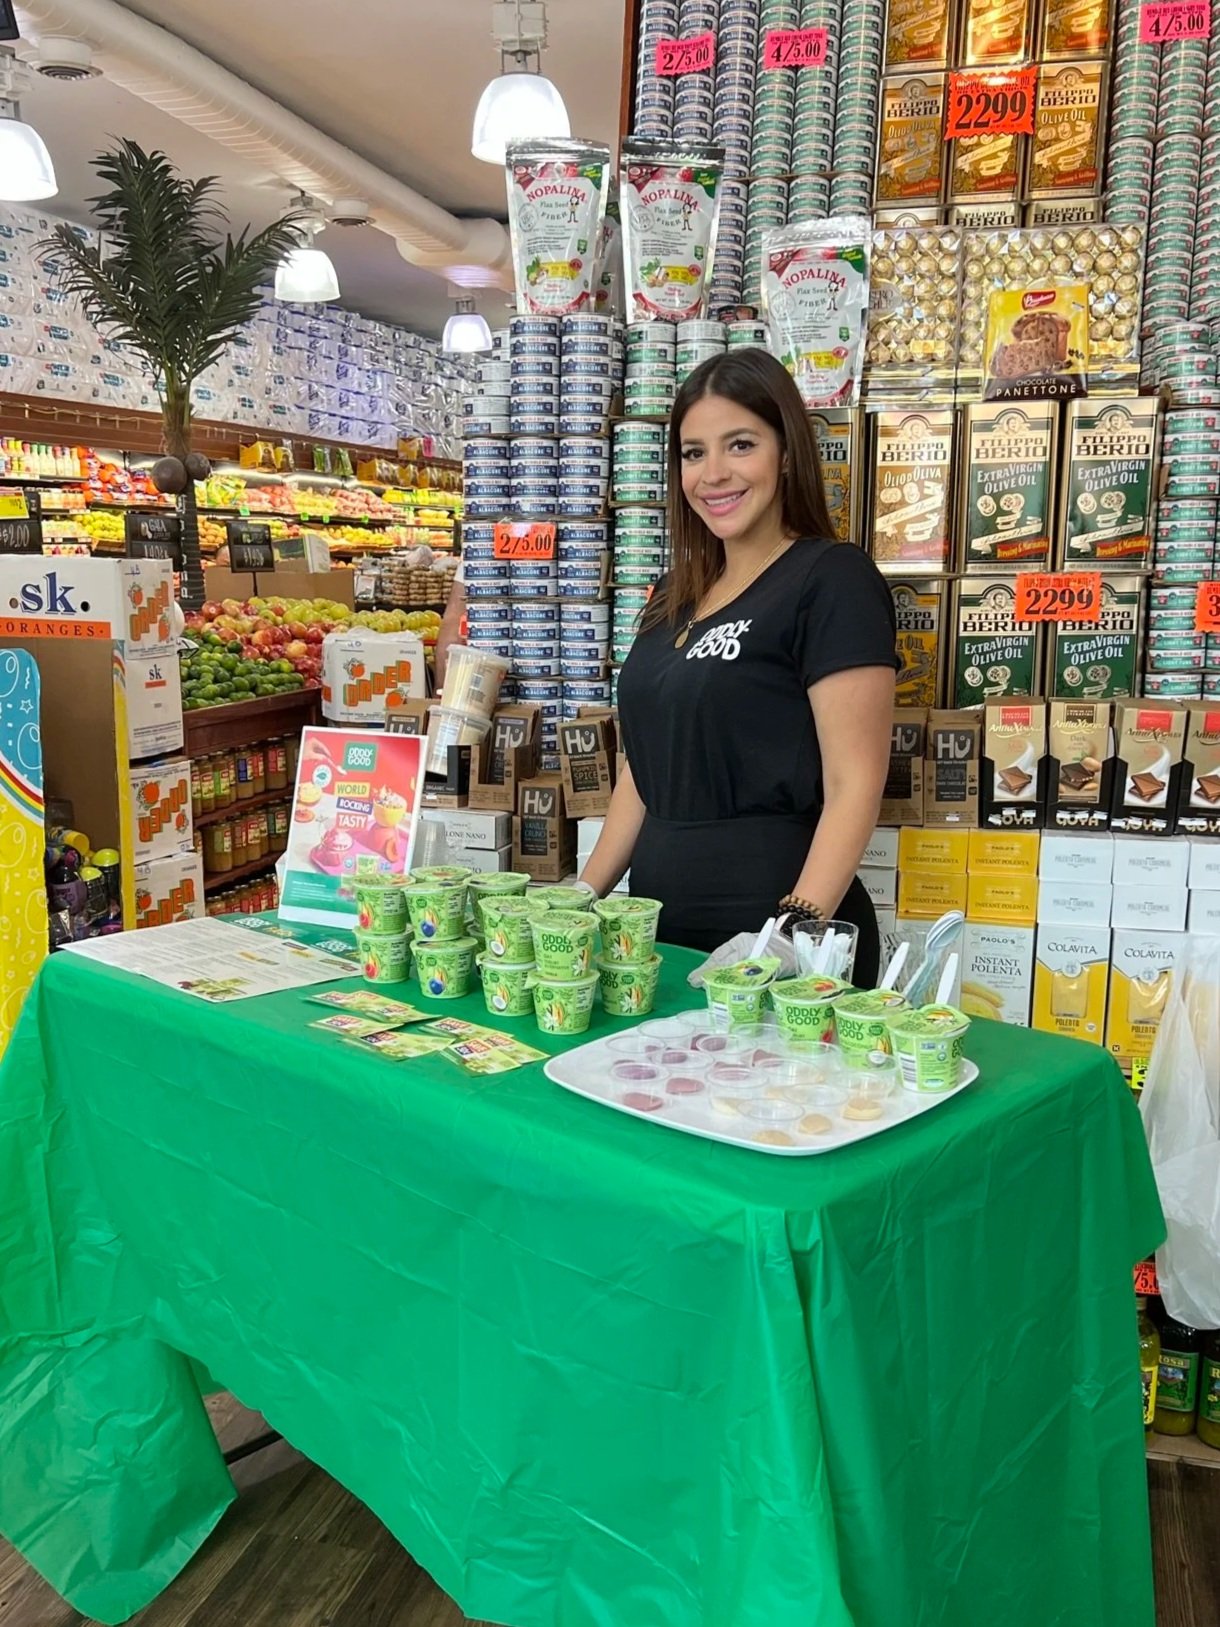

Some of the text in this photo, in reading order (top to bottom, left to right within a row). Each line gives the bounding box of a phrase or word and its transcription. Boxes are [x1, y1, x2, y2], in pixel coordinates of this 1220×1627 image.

[1149, 13, 1204, 37] 4/5.00
[771, 40, 821, 62] 4/5.00
[662, 45, 709, 71] 2/5.00
[1044, 88, 1095, 97] FILIPPO
[890, 99, 938, 109] FILIPPO
[1040, 94, 1096, 106] BERIO
[886, 105, 940, 118] BERIO
[955, 90, 1027, 129] 2299
[1041, 108, 1087, 124] OLIVE OIL
[526, 185, 586, 202] NOPALINA
[641, 188, 699, 211] NOPALINA
[1043, 206, 1086, 214] FILIPPO
[956, 216, 1015, 227] BERIO
[1033, 212, 1094, 224] BERIO
[781, 268, 847, 290] NOPALINA
[1016, 378, 1056, 386] CHOCOLATE
[996, 384, 1077, 397] PANETTONE
[980, 437, 1043, 446] FILIPPO
[1082, 435, 1147, 444] FILIPPO
[881, 450, 947, 462] BERIO
[975, 446, 1047, 459] BERIO
[1076, 444, 1150, 456] BERIO
[977, 463, 1043, 483] EXTRA VIRGIN
[1077, 460, 1146, 480] EXTRA VIRGIN
[984, 474, 1037, 495] OLIVE OIL
[1085, 471, 1138, 491] OLIVE OIL
[500, 532, 552, 554] 2/5.00
[20, 571, 77, 615] sk
[1025, 588, 1093, 615] 2299
[6, 622, 95, 637] ORANGES
[897, 619, 935, 630] RIO
[962, 620, 1033, 632] BERIO
[1062, 619, 1133, 631] BERIO
[686, 638, 741, 660] GOOD
[964, 636, 1029, 655] EXTRA VIRGIN
[1063, 635, 1130, 654] EXTRA VIRGIN
[971, 647, 1023, 666] OLIVE OIL
[1070, 646, 1124, 665] OLIVE OIL
[149, 664, 162, 680] sk
[347, 747, 373, 758] ODDLY
[347, 756, 371, 766] GOOD
[574, 770, 598, 780] SPICE
[337, 784, 367, 794] WORLD
[339, 799, 370, 812] ROCKING
[338, 815, 366, 828] TASTY
[1000, 813, 1034, 825] OYA
[465, 832, 486, 840] NANO
[980, 937, 1015, 945] PAOLO'S
[543, 943, 574, 953] GOOD
[1047, 942, 1098, 955] COLAVITA
[1124, 948, 1175, 959] COLAVITA
[975, 956, 1020, 967] INSTANT
[971, 964, 1022, 976] POLENTA
[786, 1006, 821, 1017] ODDLY
[787, 1014, 820, 1026] GOOD
